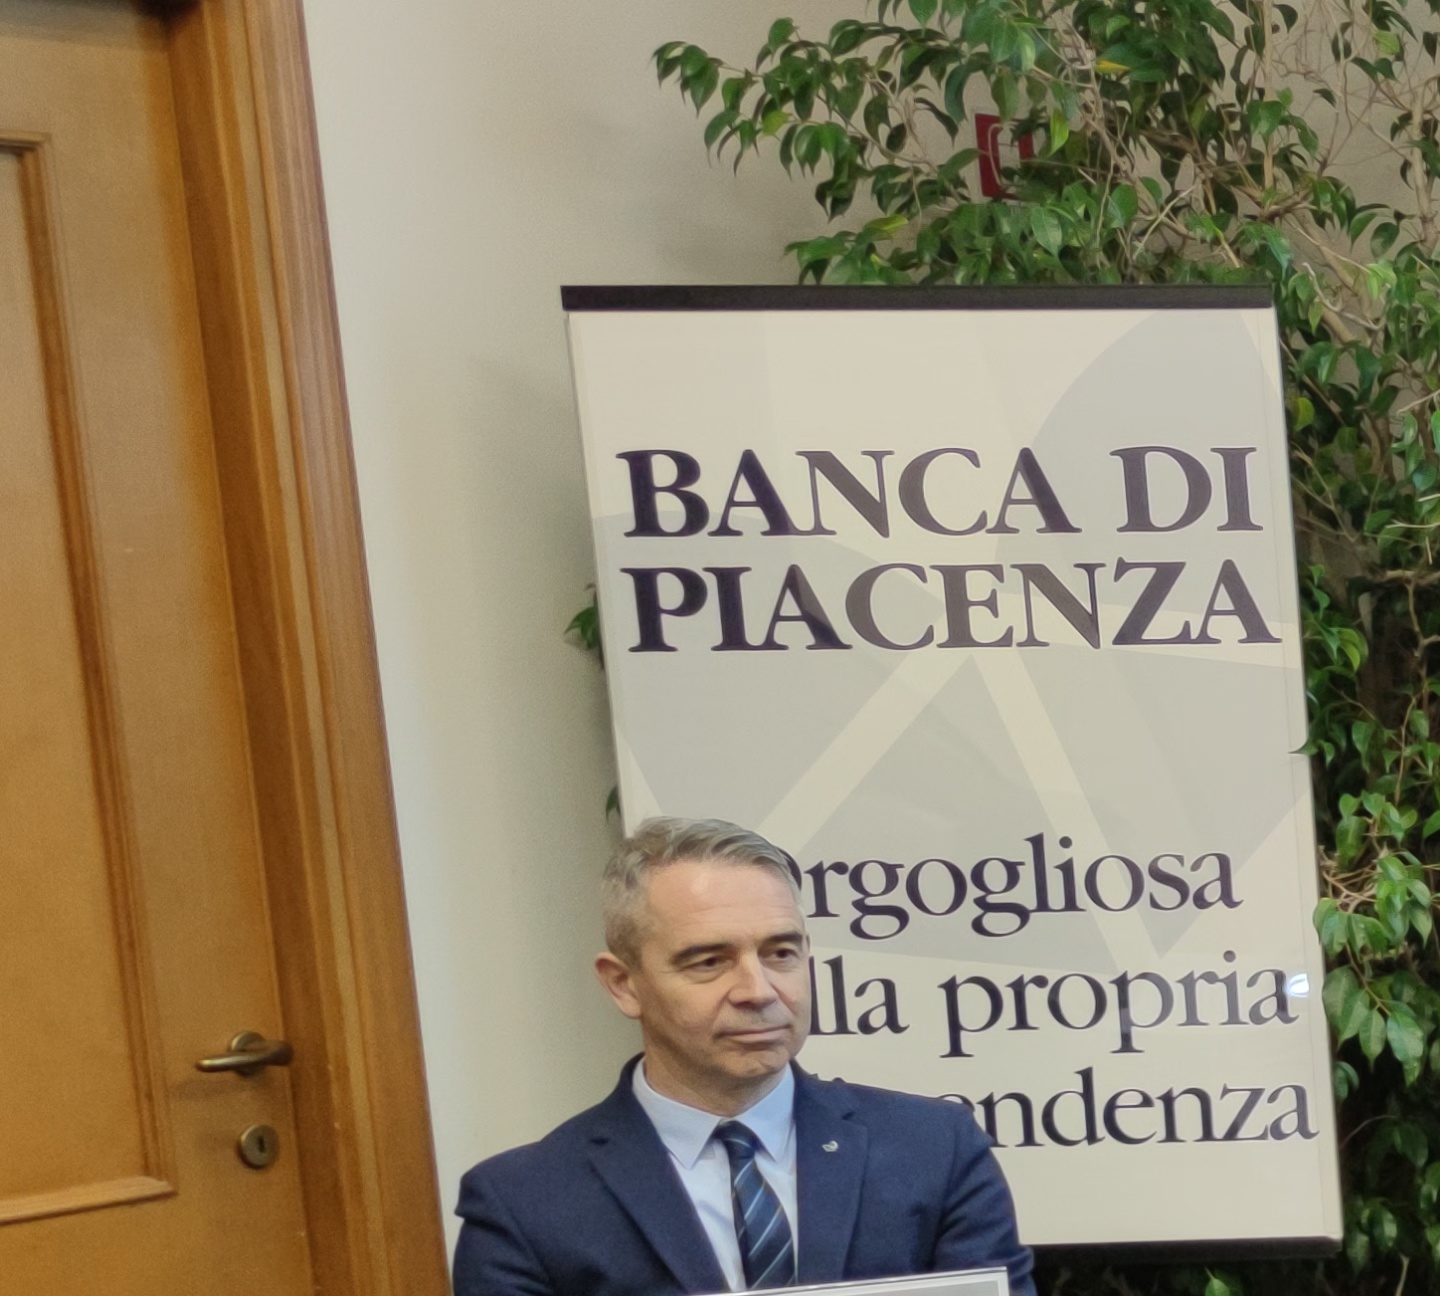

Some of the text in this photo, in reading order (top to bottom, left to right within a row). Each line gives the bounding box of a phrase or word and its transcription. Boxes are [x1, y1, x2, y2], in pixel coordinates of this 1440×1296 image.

[616, 444, 1263, 538] BANCA DI
[621, 558, 1282, 653] PIACENZA
[775, 832, 1243, 941] rgogliosa
[938, 950, 1300, 1058] propria
